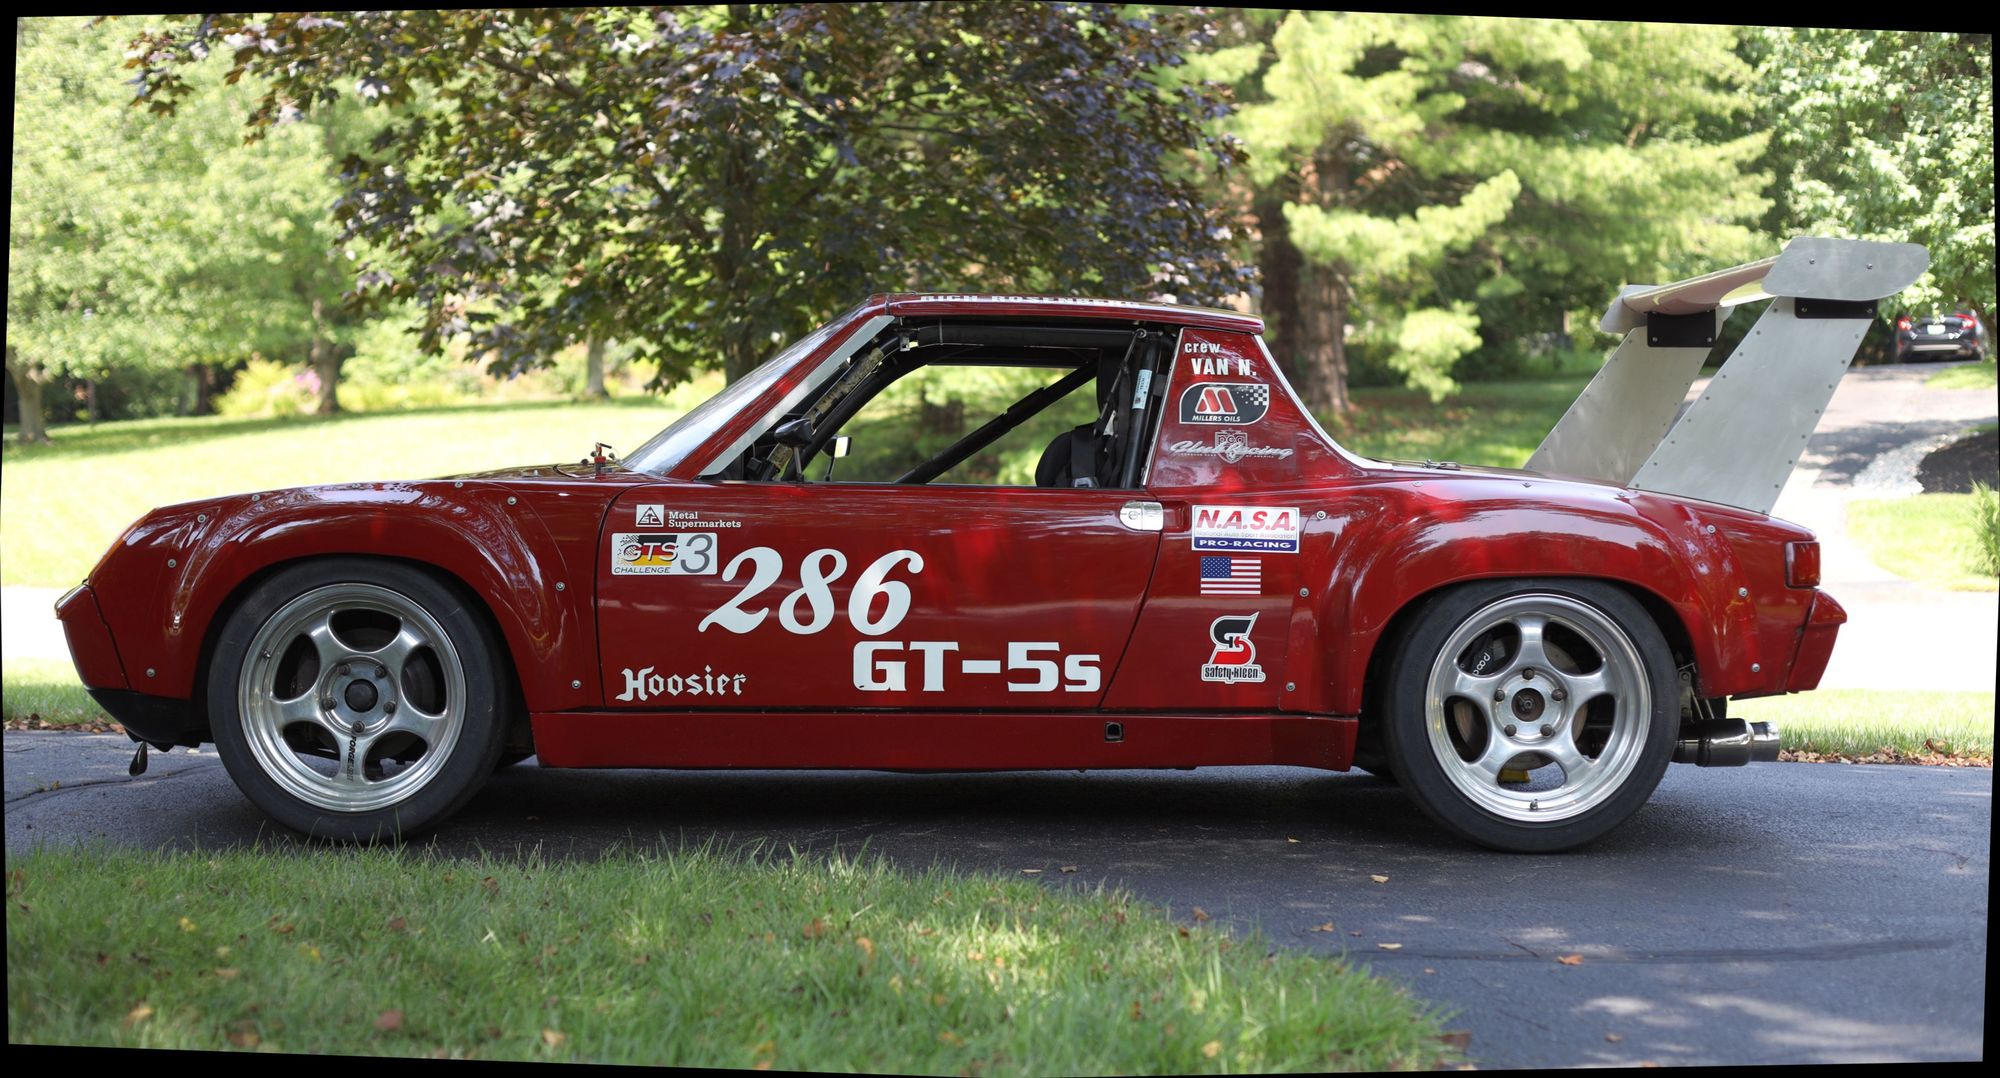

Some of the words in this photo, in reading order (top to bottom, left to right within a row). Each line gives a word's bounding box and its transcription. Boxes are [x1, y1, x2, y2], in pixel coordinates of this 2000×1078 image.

[1184, 342, 1220, 353] crew
[1191, 358, 1229, 375] VAN
[1238, 359, 1257, 376] N.
[668, 511, 698, 520] Metal
[668, 519, 741, 529] Supermarkets
[1196, 509, 1296, 531] N.A.S.A.
[623, 542, 678, 562] GTS
[680, 534, 713, 573] 3
[1199, 540, 1291, 548] PRO-RACING
[698, 546, 924, 635] 286
[852, 641, 1101, 692] GT-5s
[615, 664, 747, 701] Hoosier
